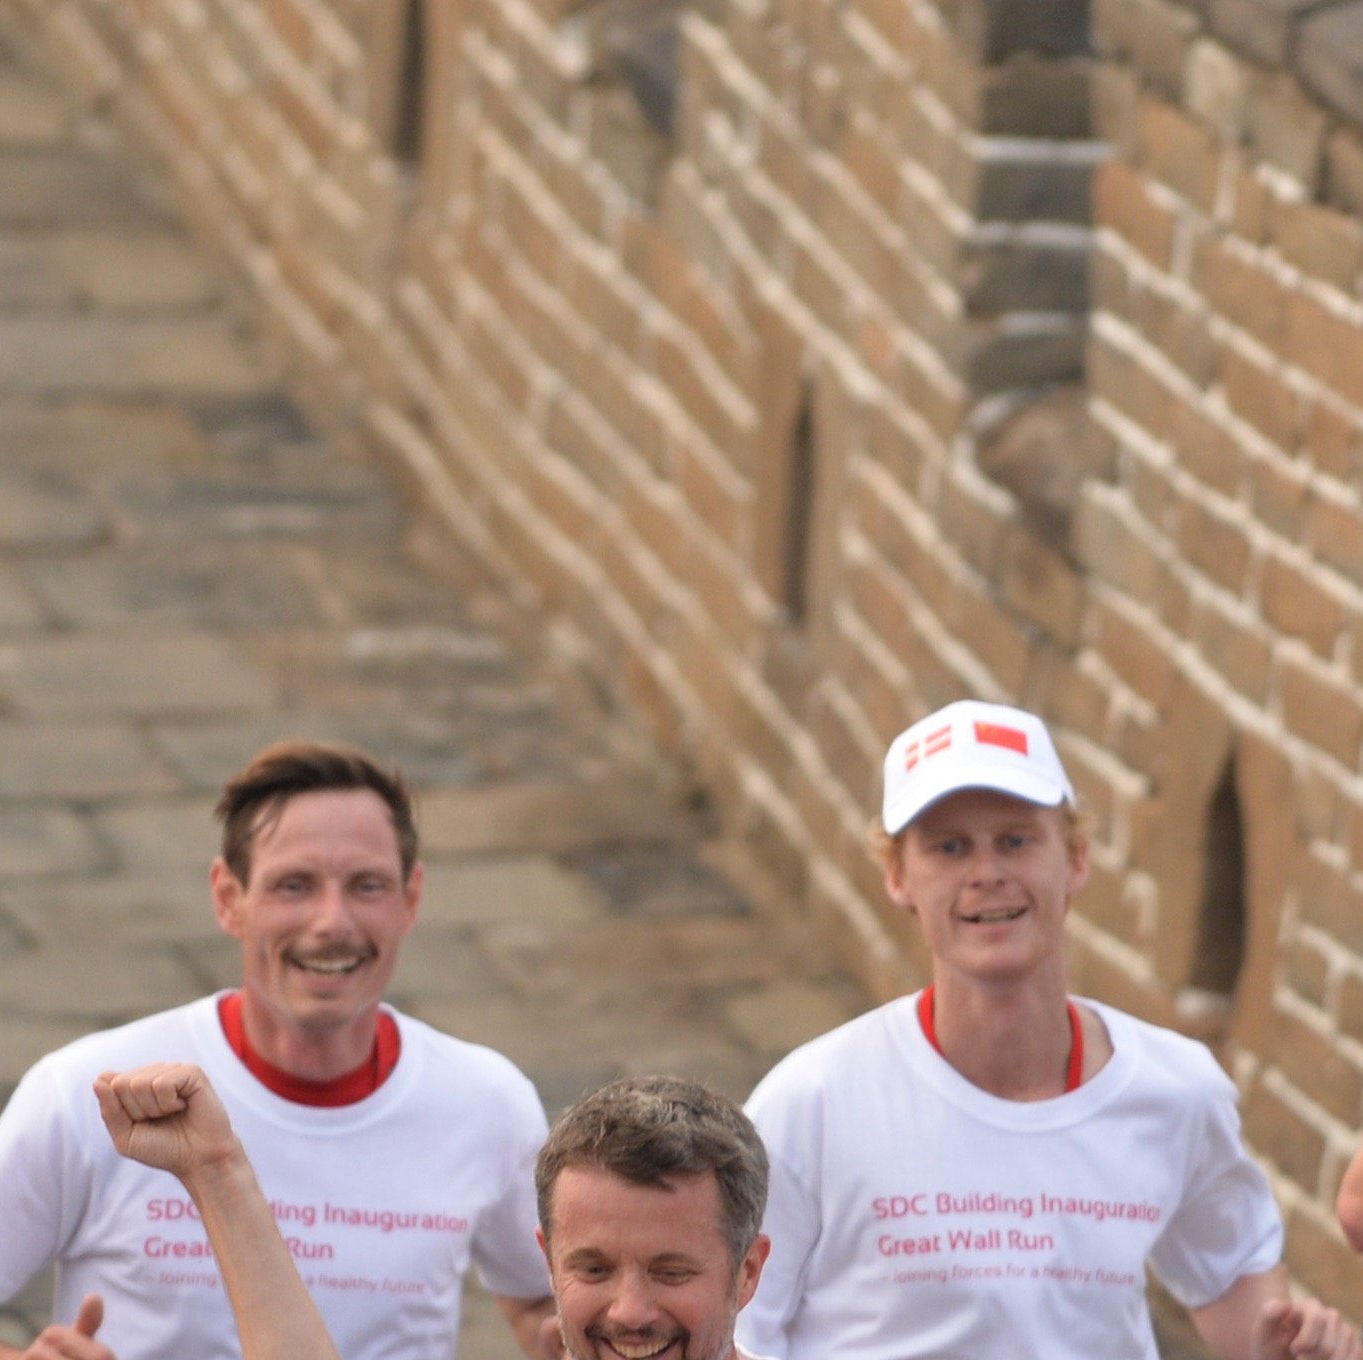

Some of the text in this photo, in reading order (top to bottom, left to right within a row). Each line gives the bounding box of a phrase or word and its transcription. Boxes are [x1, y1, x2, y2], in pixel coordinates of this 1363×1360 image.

[324, 1202, 469, 1234] Inauguration
[872, 1194, 928, 1220] SDC
[935, 1193, 1033, 1218] Building
[878, 1229, 1054, 1256] Great Wall Run
